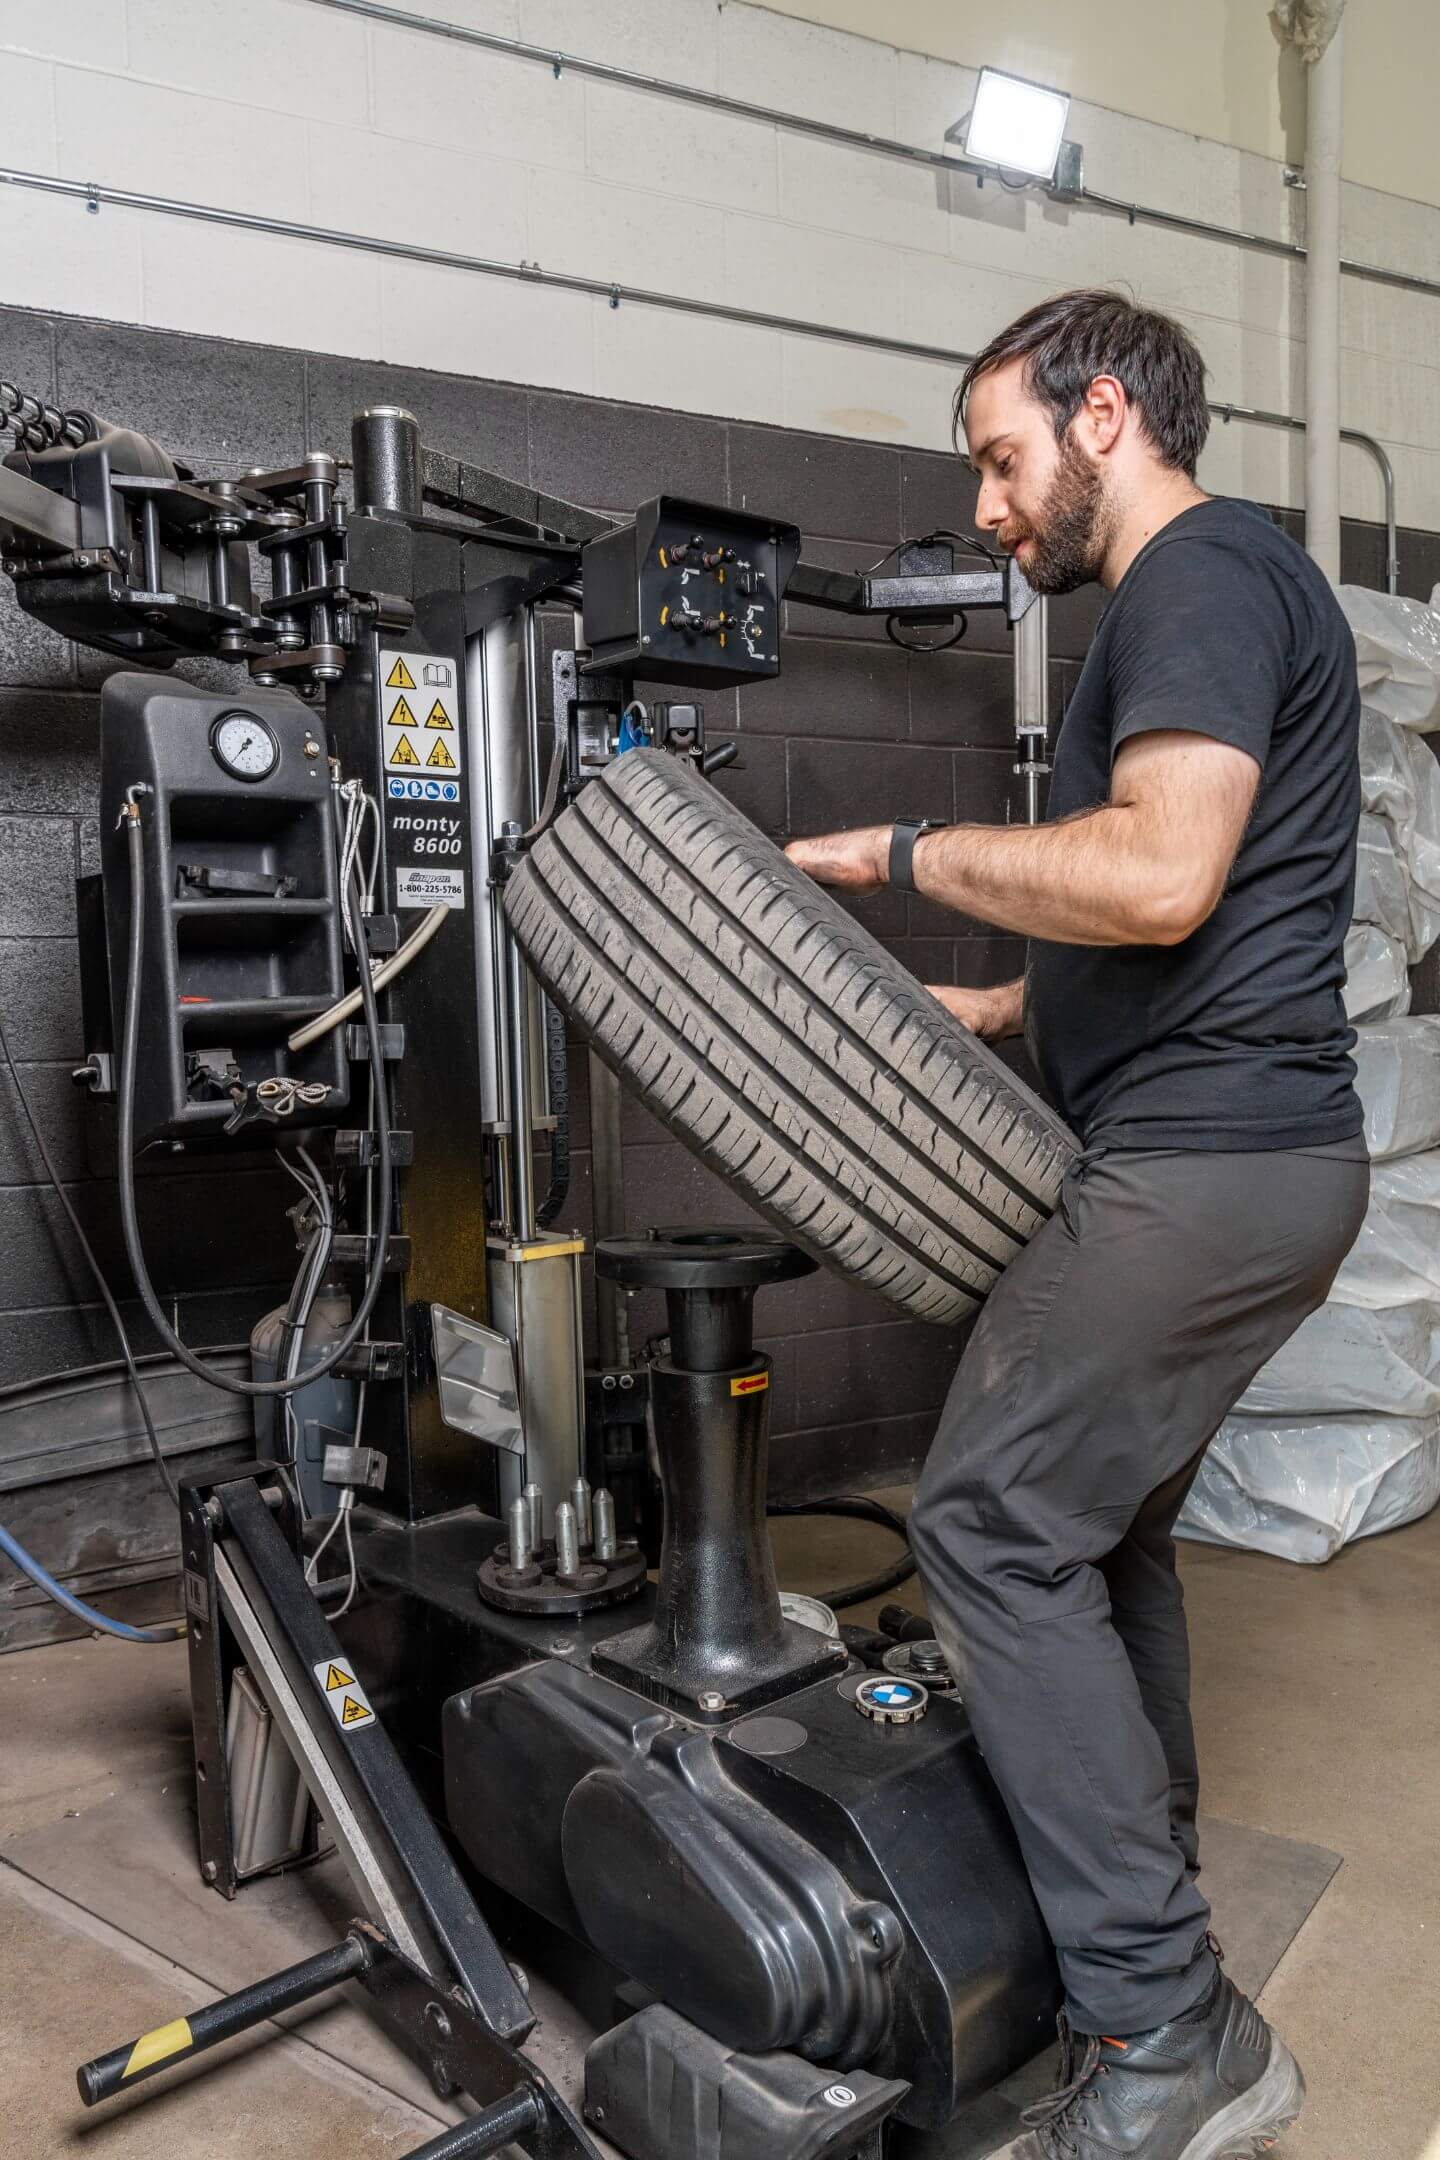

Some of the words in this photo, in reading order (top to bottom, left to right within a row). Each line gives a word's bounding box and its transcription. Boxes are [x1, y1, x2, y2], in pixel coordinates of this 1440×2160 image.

[393, 816, 461, 836] monty
[413, 837, 462, 855] 8600
[399, 884, 462, 894] 1-800-225-5786
